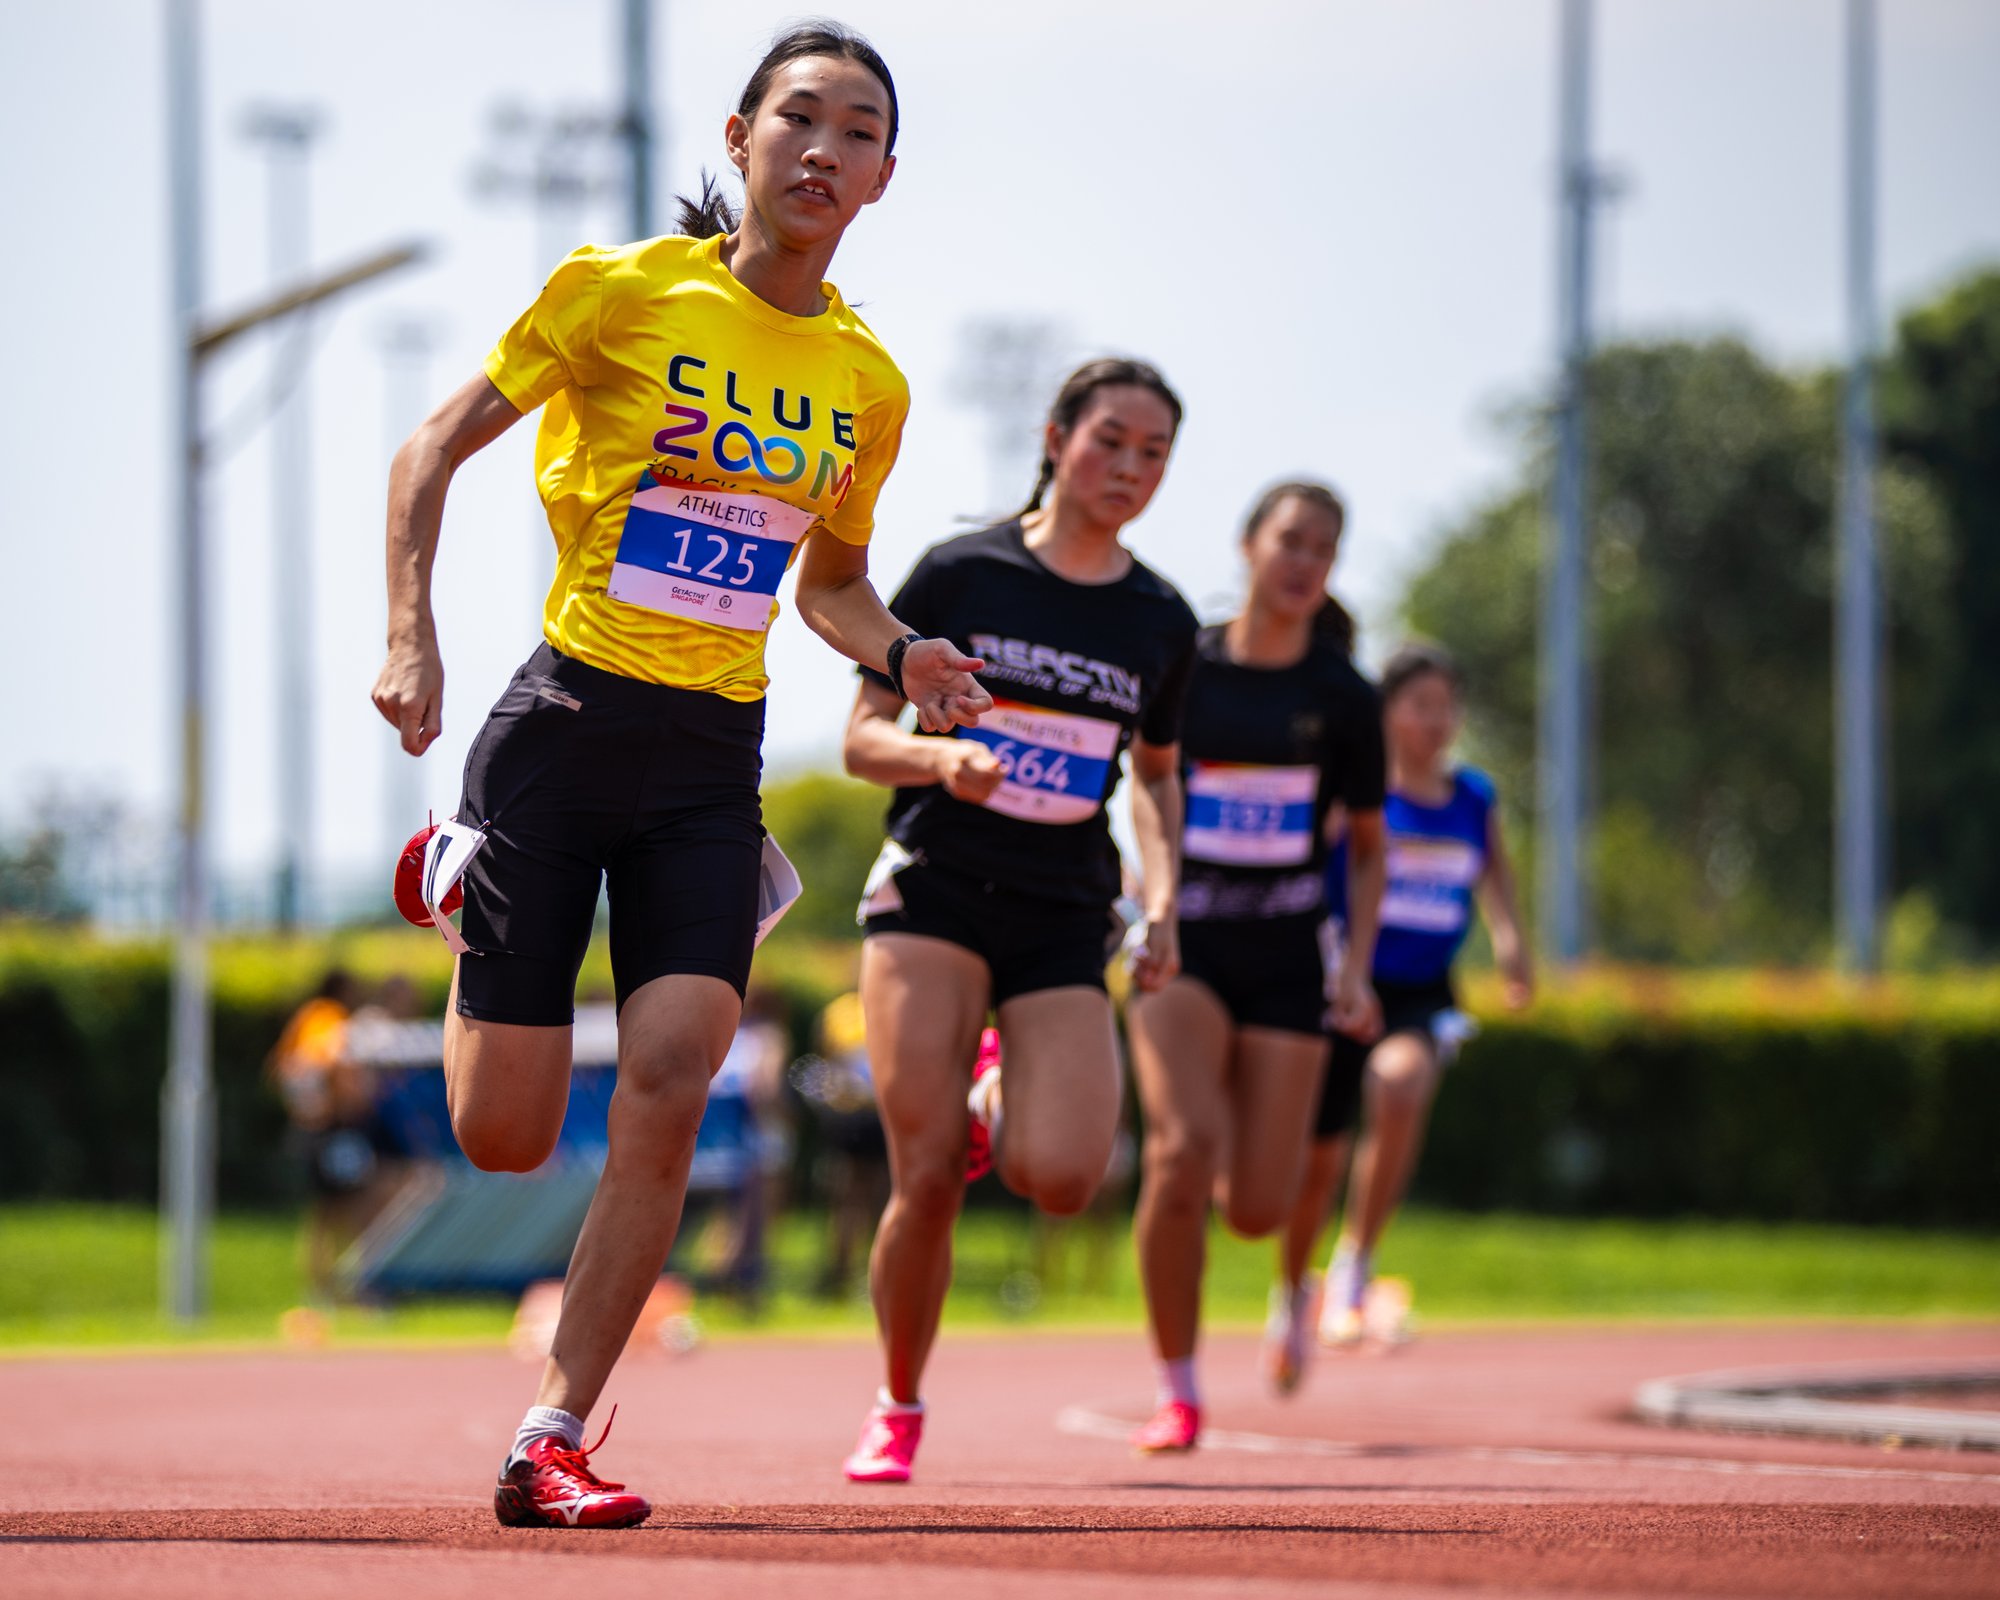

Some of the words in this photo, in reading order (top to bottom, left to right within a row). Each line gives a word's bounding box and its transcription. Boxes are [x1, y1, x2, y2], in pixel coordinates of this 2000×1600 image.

[667, 354, 857, 451] CLUB
[677, 494, 768, 528] ATHLETICS
[665, 528, 759, 586] 125
[670, 593, 705, 607] SINGAPORE
[983, 662, 1055, 691] STITUTE
[992, 740, 1070, 793] 664
